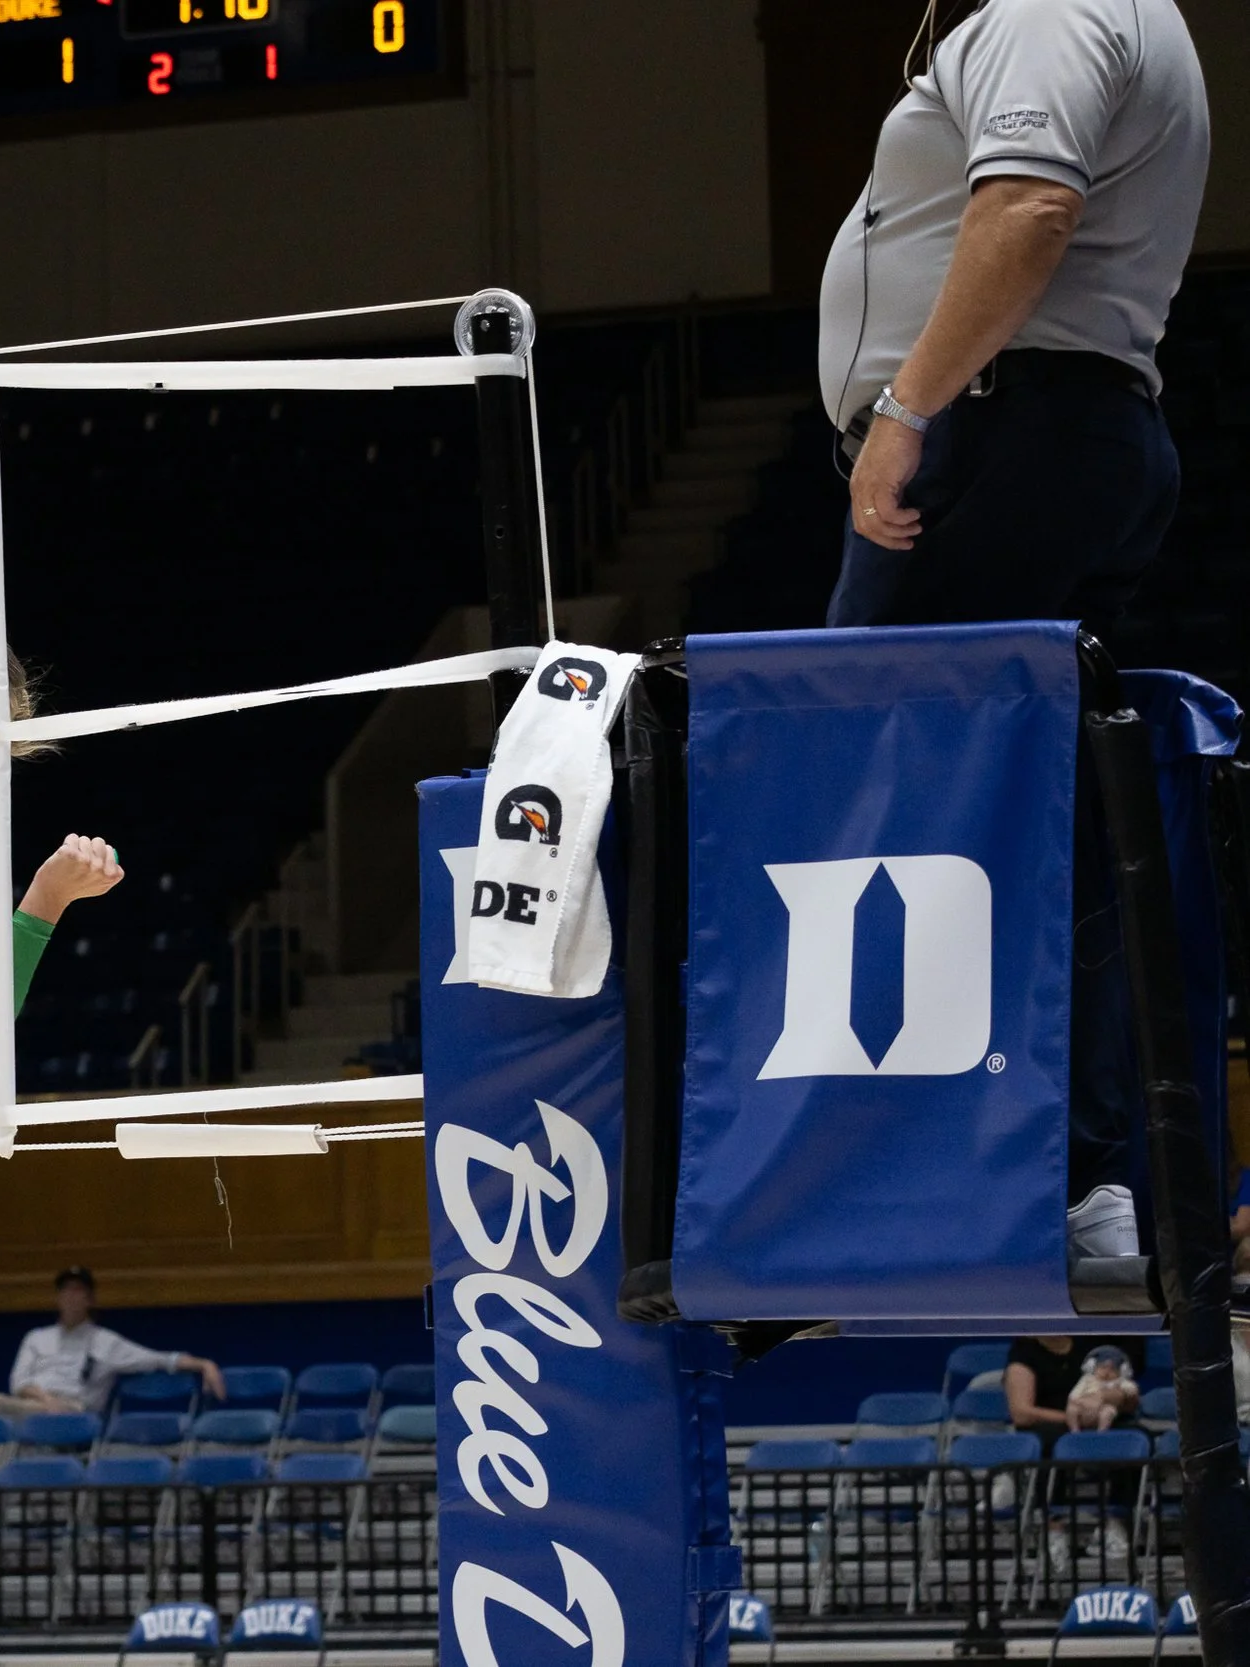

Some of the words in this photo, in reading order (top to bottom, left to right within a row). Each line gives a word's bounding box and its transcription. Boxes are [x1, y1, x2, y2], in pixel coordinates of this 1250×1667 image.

[373, 0, 405, 53] 0
[62, 37, 74, 84] 1
[148, 52, 173, 95] 2
[266, 43, 277, 80] 1
[756, 854, 992, 1080] D
[435, 1100, 608, 1516] Blue
[139, 1607, 215, 1642] DUKE
[240, 1604, 314, 1637] DUKE
[1074, 1591, 1150, 1625] DUKE
